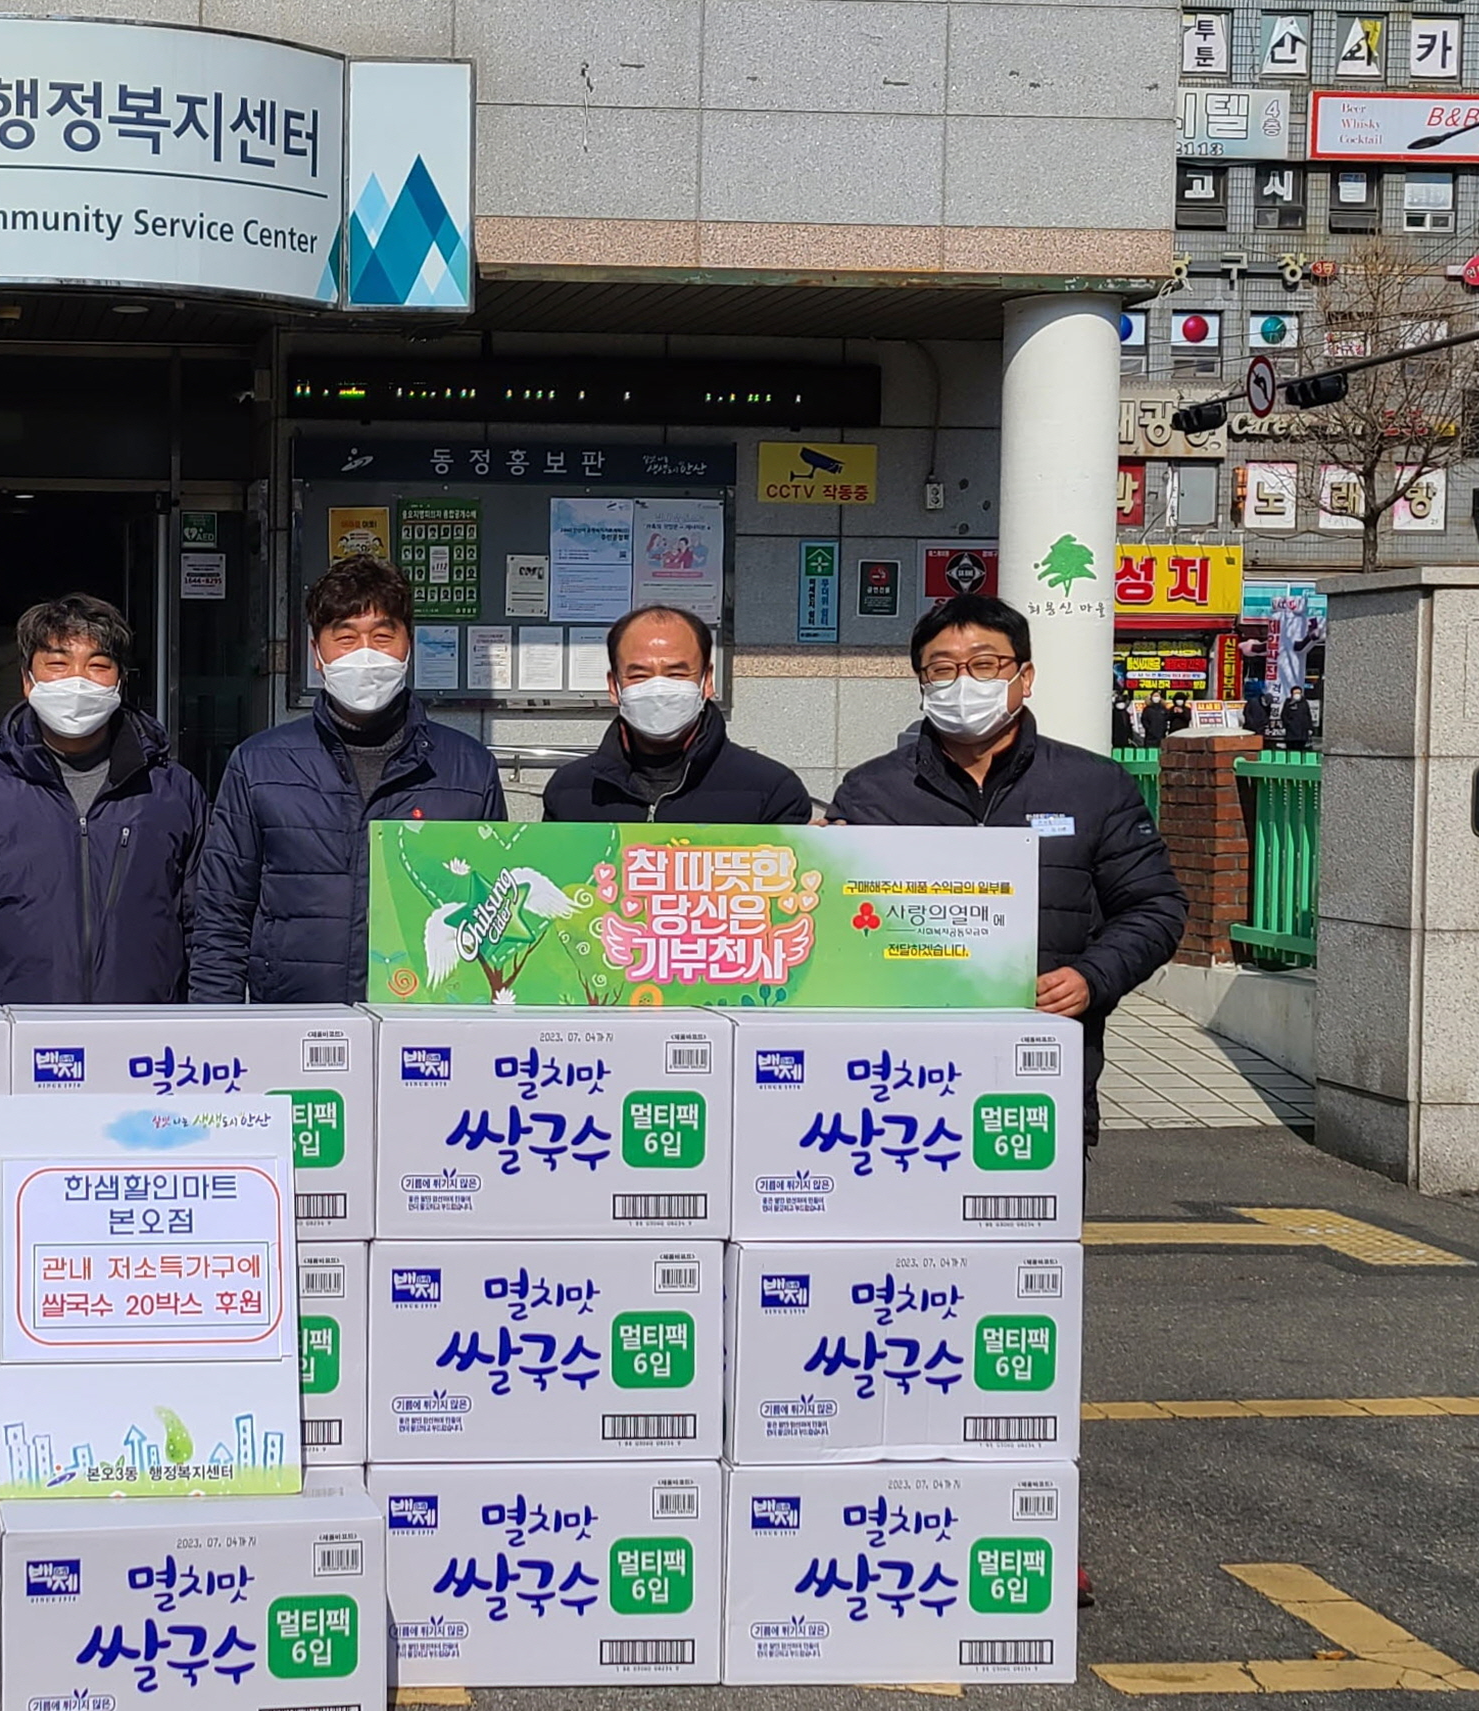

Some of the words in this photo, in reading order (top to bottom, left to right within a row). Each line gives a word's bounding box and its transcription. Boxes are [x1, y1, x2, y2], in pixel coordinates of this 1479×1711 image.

[1341, 103, 1367, 114] Beer
[1341, 118, 1382, 131] Whisky
[1339, 133, 1383, 145] Cocktail
[133, 208, 234, 244] Service
[242, 219, 318, 255] Center
[430, 448, 605, 476] 동정홍보판
[766, 484, 815, 498] CCTV
[822, 484, 869, 501] 작동중
[195, 532, 214, 542] AED
[627, 848, 668, 892] 참
[674, 847, 791, 893] 따뜻한
[847, 880, 903, 894] 구매해주신
[905, 882, 927, 894] 제품
[931, 882, 974, 894] 수익금의
[978, 882, 1010, 894] 일부를
[455, 867, 518, 962] Chilsung
[651, 895, 767, 937] 당신은
[886, 905, 988, 926] 사랑의열매
[993, 914, 1005, 926] 에
[631, 936, 787, 981] 기부천사
[888, 944, 969, 957] 전달하겠습니다.
[494, 1046, 611, 1100] 멸치맛
[847, 1049, 962, 1102] 멸치맛
[241, 1112, 271, 1127] 안산
[292, 1101, 338, 1129] 티팩
[630, 1102, 699, 1130] 멀티팩
[980, 1105, 1049, 1132] 멀티팩
[446, 1105, 612, 1175] 쌀국수
[644, 1131, 682, 1157] 6입
[799, 1107, 963, 1177] 쌀국수
[994, 1134, 1032, 1160] 6입
[109, 1208, 193, 1235] 본오점
[41, 1255, 93, 1282] 관내
[108, 1254, 261, 1281] 저소득가구에
[41, 1293, 114, 1318] 쌀국수
[125, 1292, 204, 1318] 20박스
[215, 1291, 263, 1316] 후원
[484, 1267, 601, 1321] 멸치맛
[851, 1273, 964, 1326] 멸치맛
[619, 1323, 688, 1351] 멀티팩
[982, 1327, 1050, 1355] 멀티팩
[436, 1326, 602, 1396] 쌀국수
[633, 1351, 671, 1378] 6입
[804, 1331, 964, 1399] 쌀국수
[995, 1355, 1033, 1381] 6입
[87, 1464, 139, 1483] 본오3동
[149, 1463, 235, 1482] 행정복지센터
[481, 1494, 598, 1547] 멸치맛
[843, 1495, 959, 1548] 멸치맛
[176, 1538, 202, 1549] 2023.
[617, 1549, 687, 1576] 멀티팩
[977, 1549, 1046, 1577] 멀티팩
[128, 1554, 255, 1612] 멸치맛
[433, 1552, 600, 1622] 쌀국수
[632, 1578, 669, 1604] 6입
[795, 1553, 959, 1622] 쌀국수
[991, 1578, 1029, 1604] 6입
[275, 1607, 351, 1638] 멀티팩
[76, 1618, 257, 1693] 쌀국수
[291, 1639, 332, 1667] 6입
